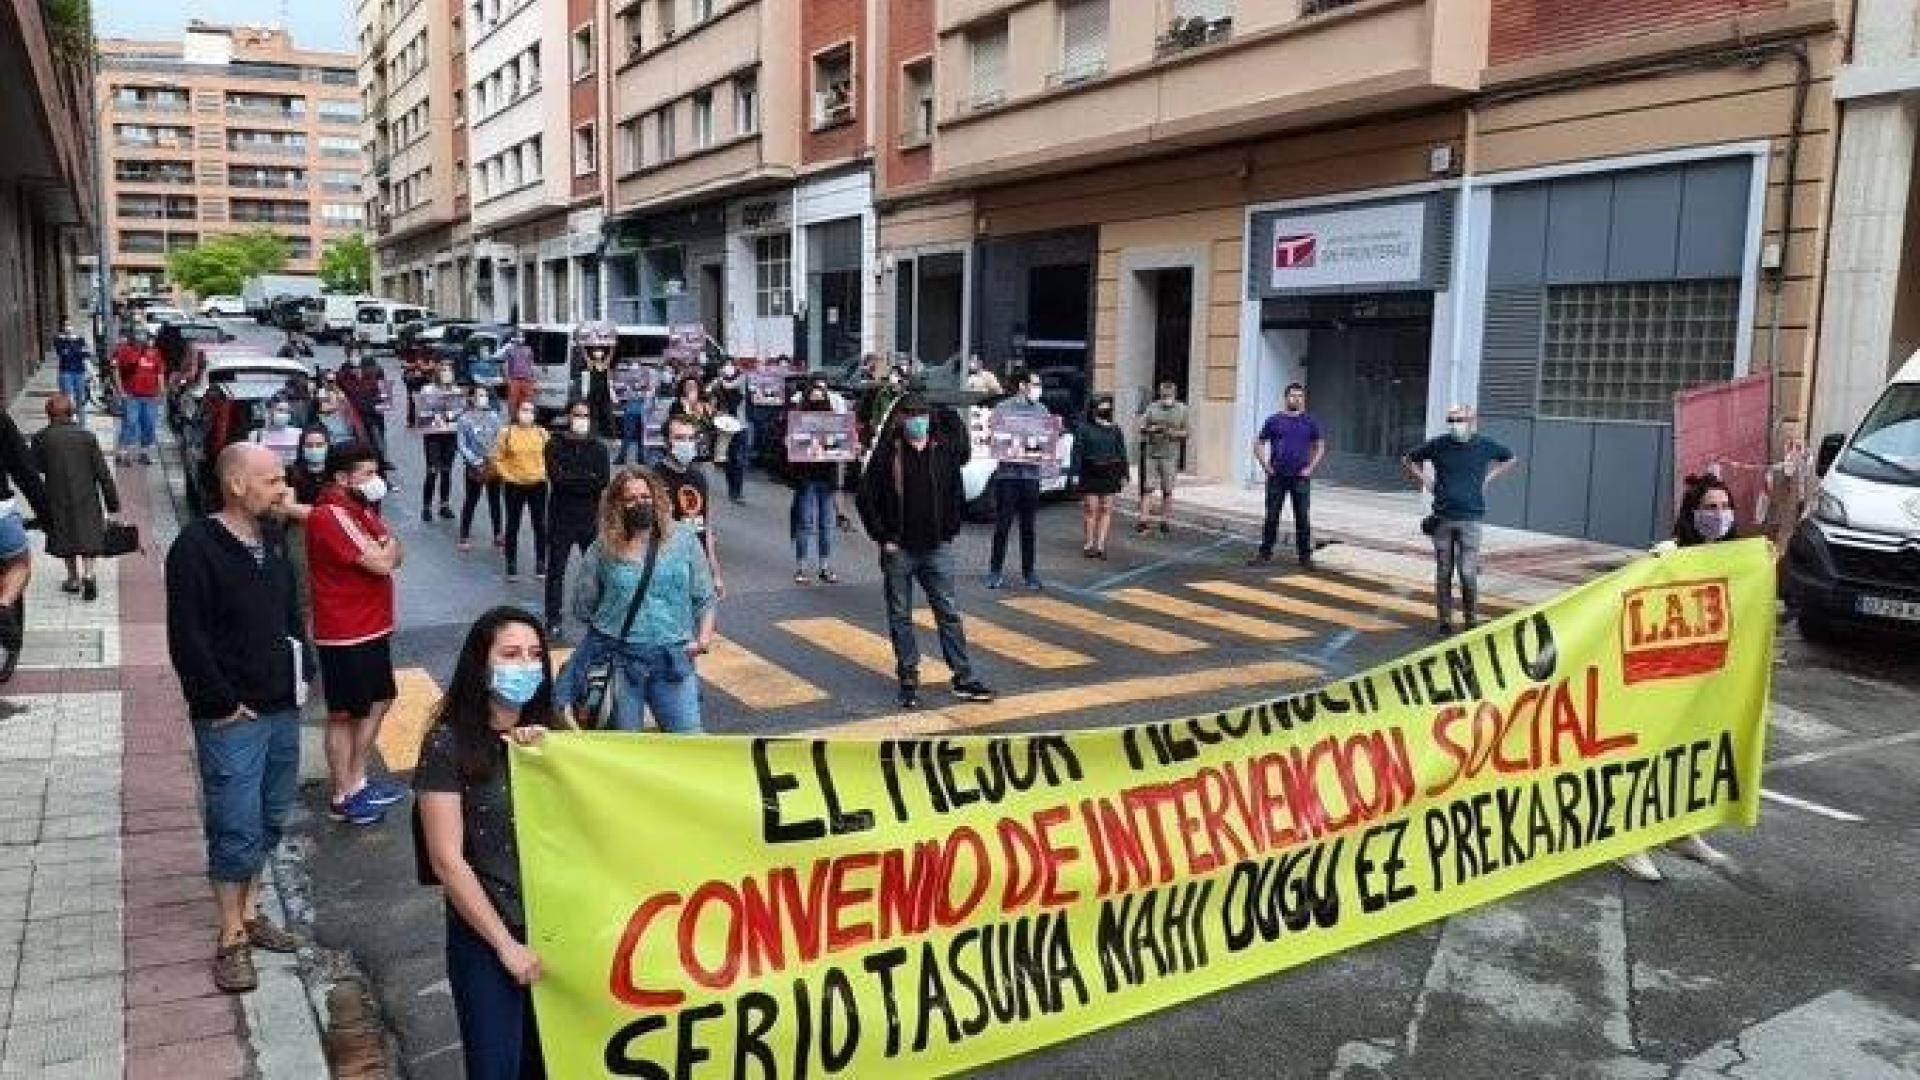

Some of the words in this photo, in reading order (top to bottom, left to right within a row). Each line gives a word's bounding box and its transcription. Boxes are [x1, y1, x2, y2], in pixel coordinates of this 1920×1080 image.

[1628, 585, 1724, 646] LAB
[609, 826, 992, 1007] CONVENIO
[996, 804, 1081, 910] DE
[1081, 727, 1416, 899] INTERVENCION
[1424, 665, 1639, 798] SOCIAL
[751, 738, 875, 844] EL
[1098, 878, 1214, 993] NAHI
[1355, 821, 1418, 913] EZ
[1425, 729, 1740, 890] PREKARIETATEA
